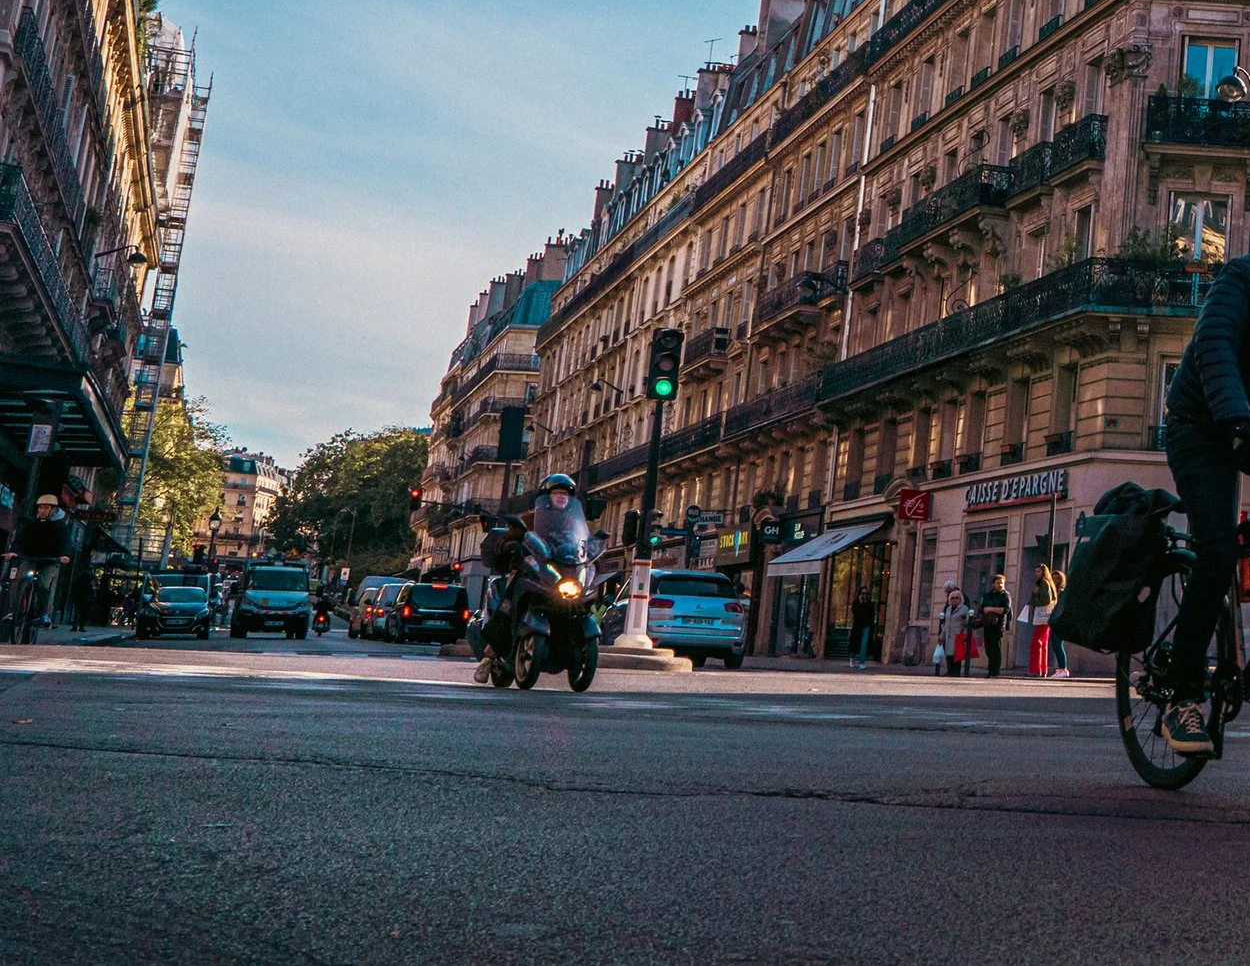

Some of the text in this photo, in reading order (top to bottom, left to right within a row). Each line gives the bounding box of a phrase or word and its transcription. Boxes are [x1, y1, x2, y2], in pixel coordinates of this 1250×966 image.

[965, 470, 1065, 506] CAISSE D'EPARGNE
[764, 525, 779, 535] GH
